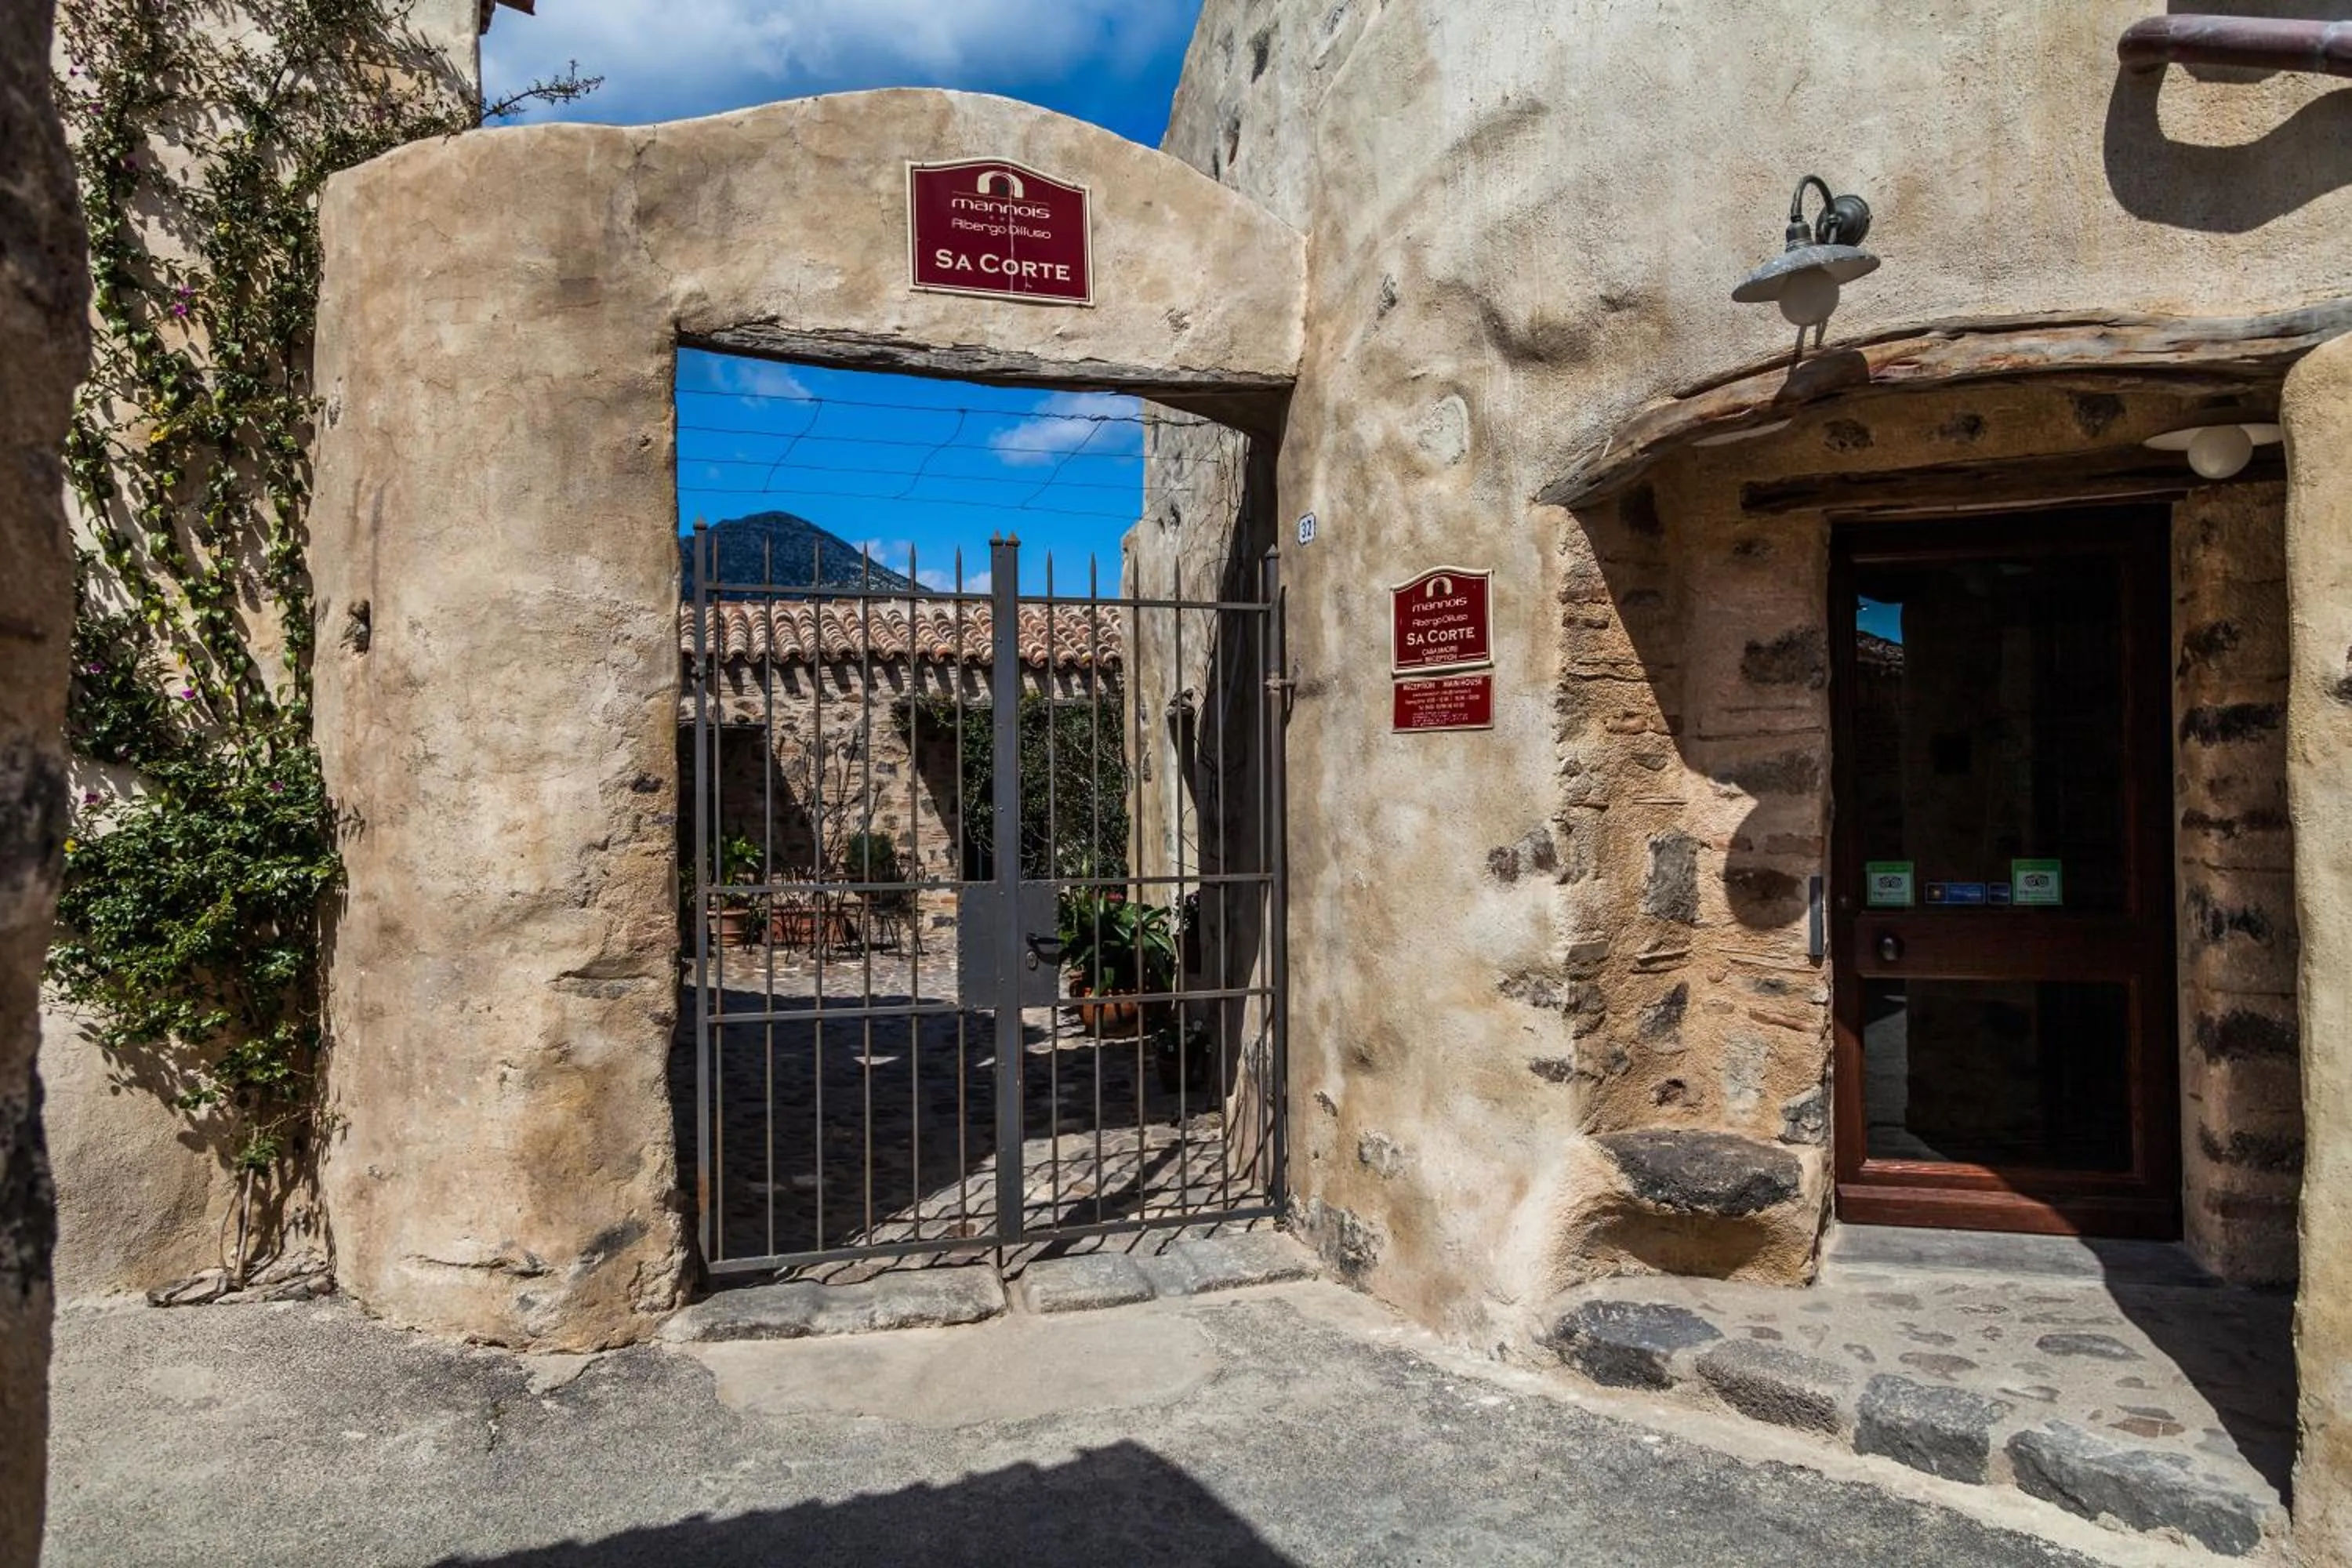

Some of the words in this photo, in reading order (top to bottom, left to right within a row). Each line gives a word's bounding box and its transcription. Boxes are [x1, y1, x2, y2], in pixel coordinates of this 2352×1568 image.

[952, 198, 1051, 219] mannois
[952, 217, 1007, 236] Albergo
[935, 249, 973, 271] SA
[979, 253, 1071, 281] CORTE
[1412, 597, 1468, 612] mannois
[1406, 632, 1425, 646] SA
[1428, 626, 1475, 643] CORTE
